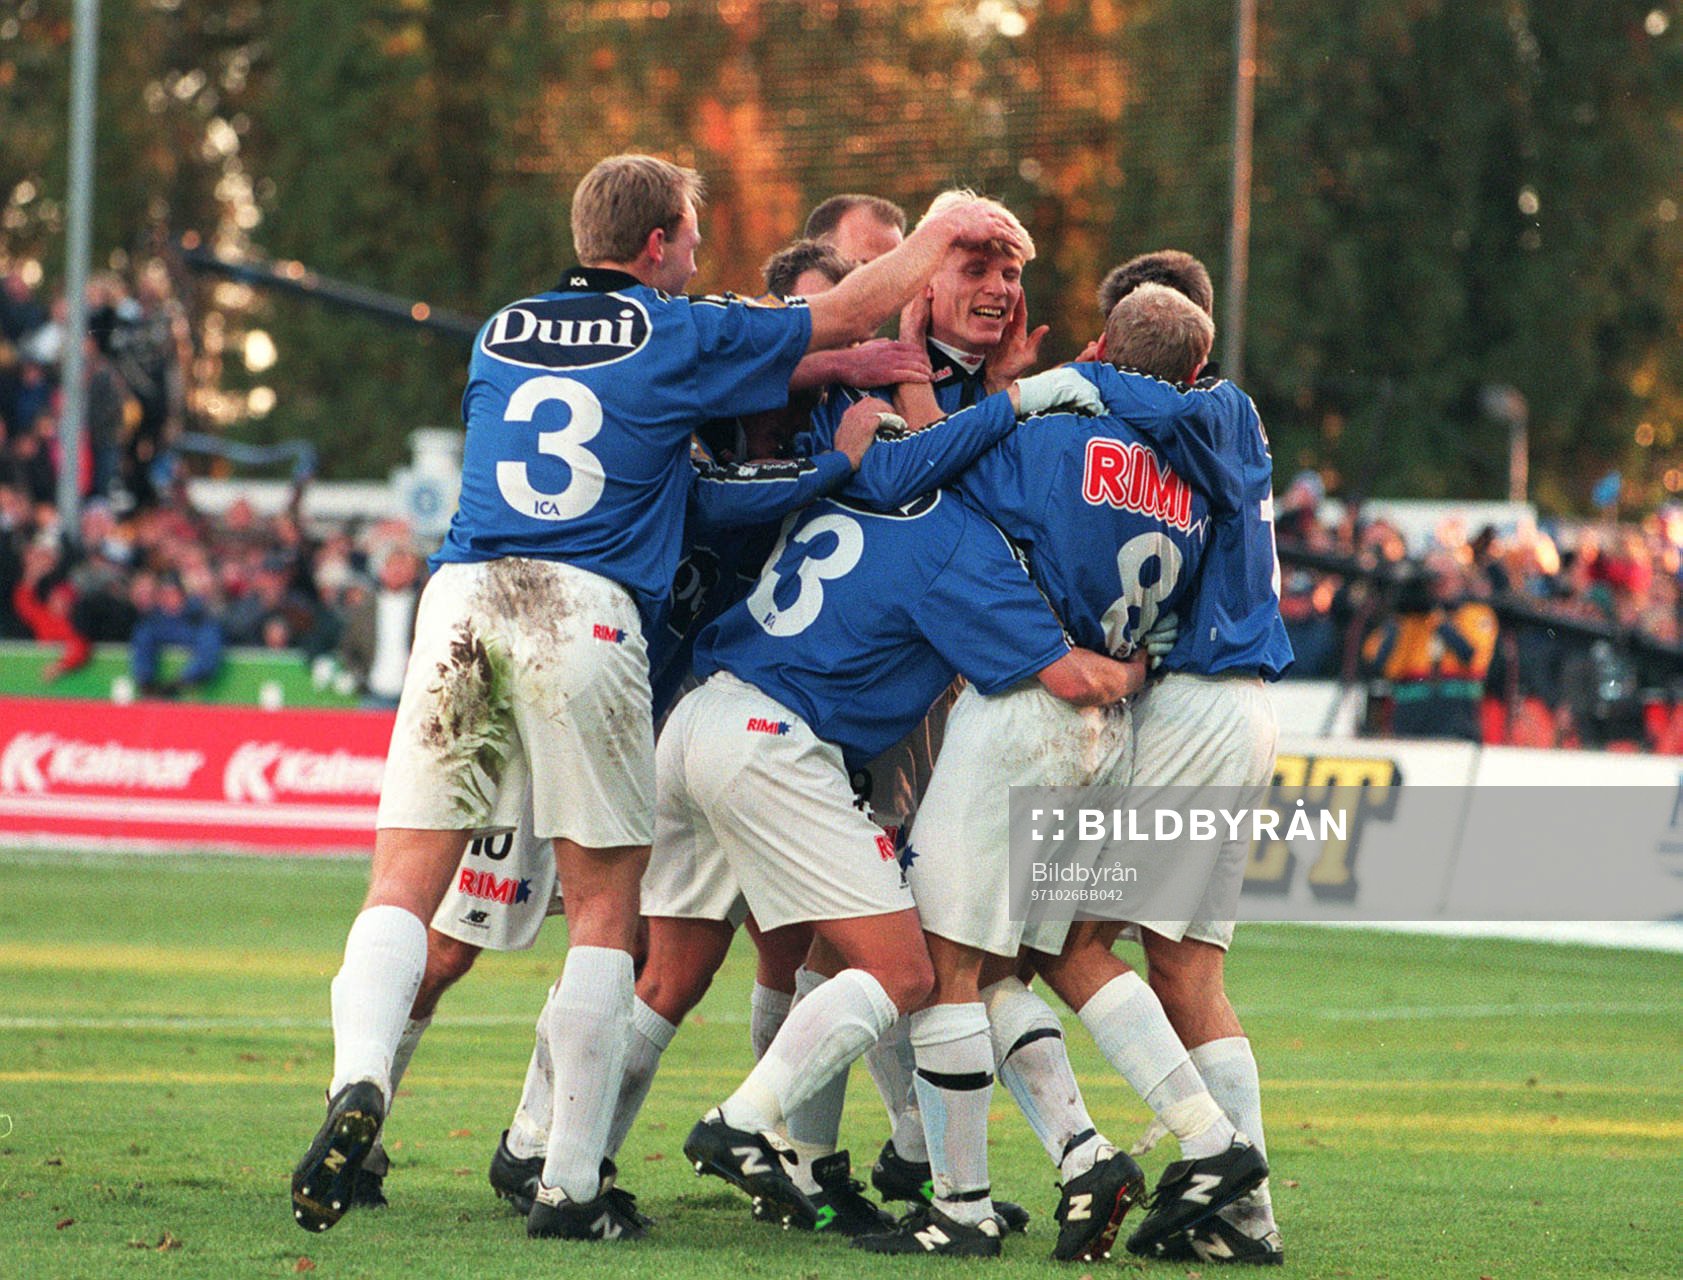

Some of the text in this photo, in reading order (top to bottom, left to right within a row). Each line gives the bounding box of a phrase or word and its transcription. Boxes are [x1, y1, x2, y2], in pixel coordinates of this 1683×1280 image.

[570, 277, 588, 286] ICA
[487, 309, 636, 348] Duni
[496, 376, 606, 520] 3
[1082, 437, 1193, 533] RIMI
[534, 501, 560, 516] ICA
[1100, 531, 1183, 657] 8
[593, 623, 618, 643] RIM
[747, 717, 779, 736] RIMI
[458, 867, 517, 905] RIMI
